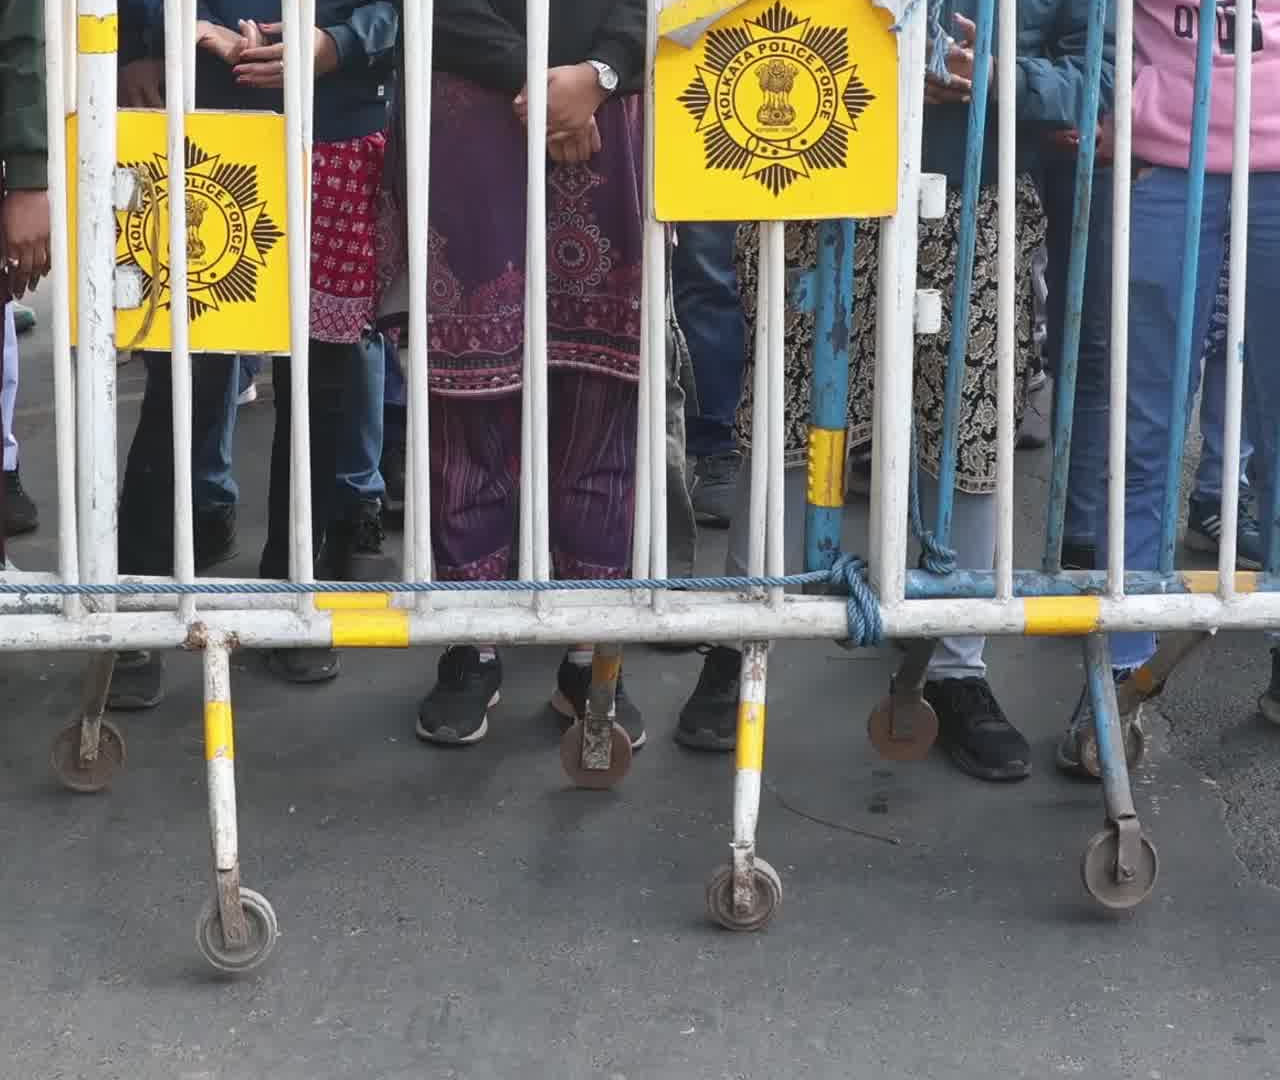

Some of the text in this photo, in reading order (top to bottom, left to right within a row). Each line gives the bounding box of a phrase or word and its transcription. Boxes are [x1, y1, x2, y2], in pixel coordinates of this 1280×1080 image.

[719, 40, 834, 121] KOLKATA POLICE FORCE
[223, 201, 243, 256] FORCE
